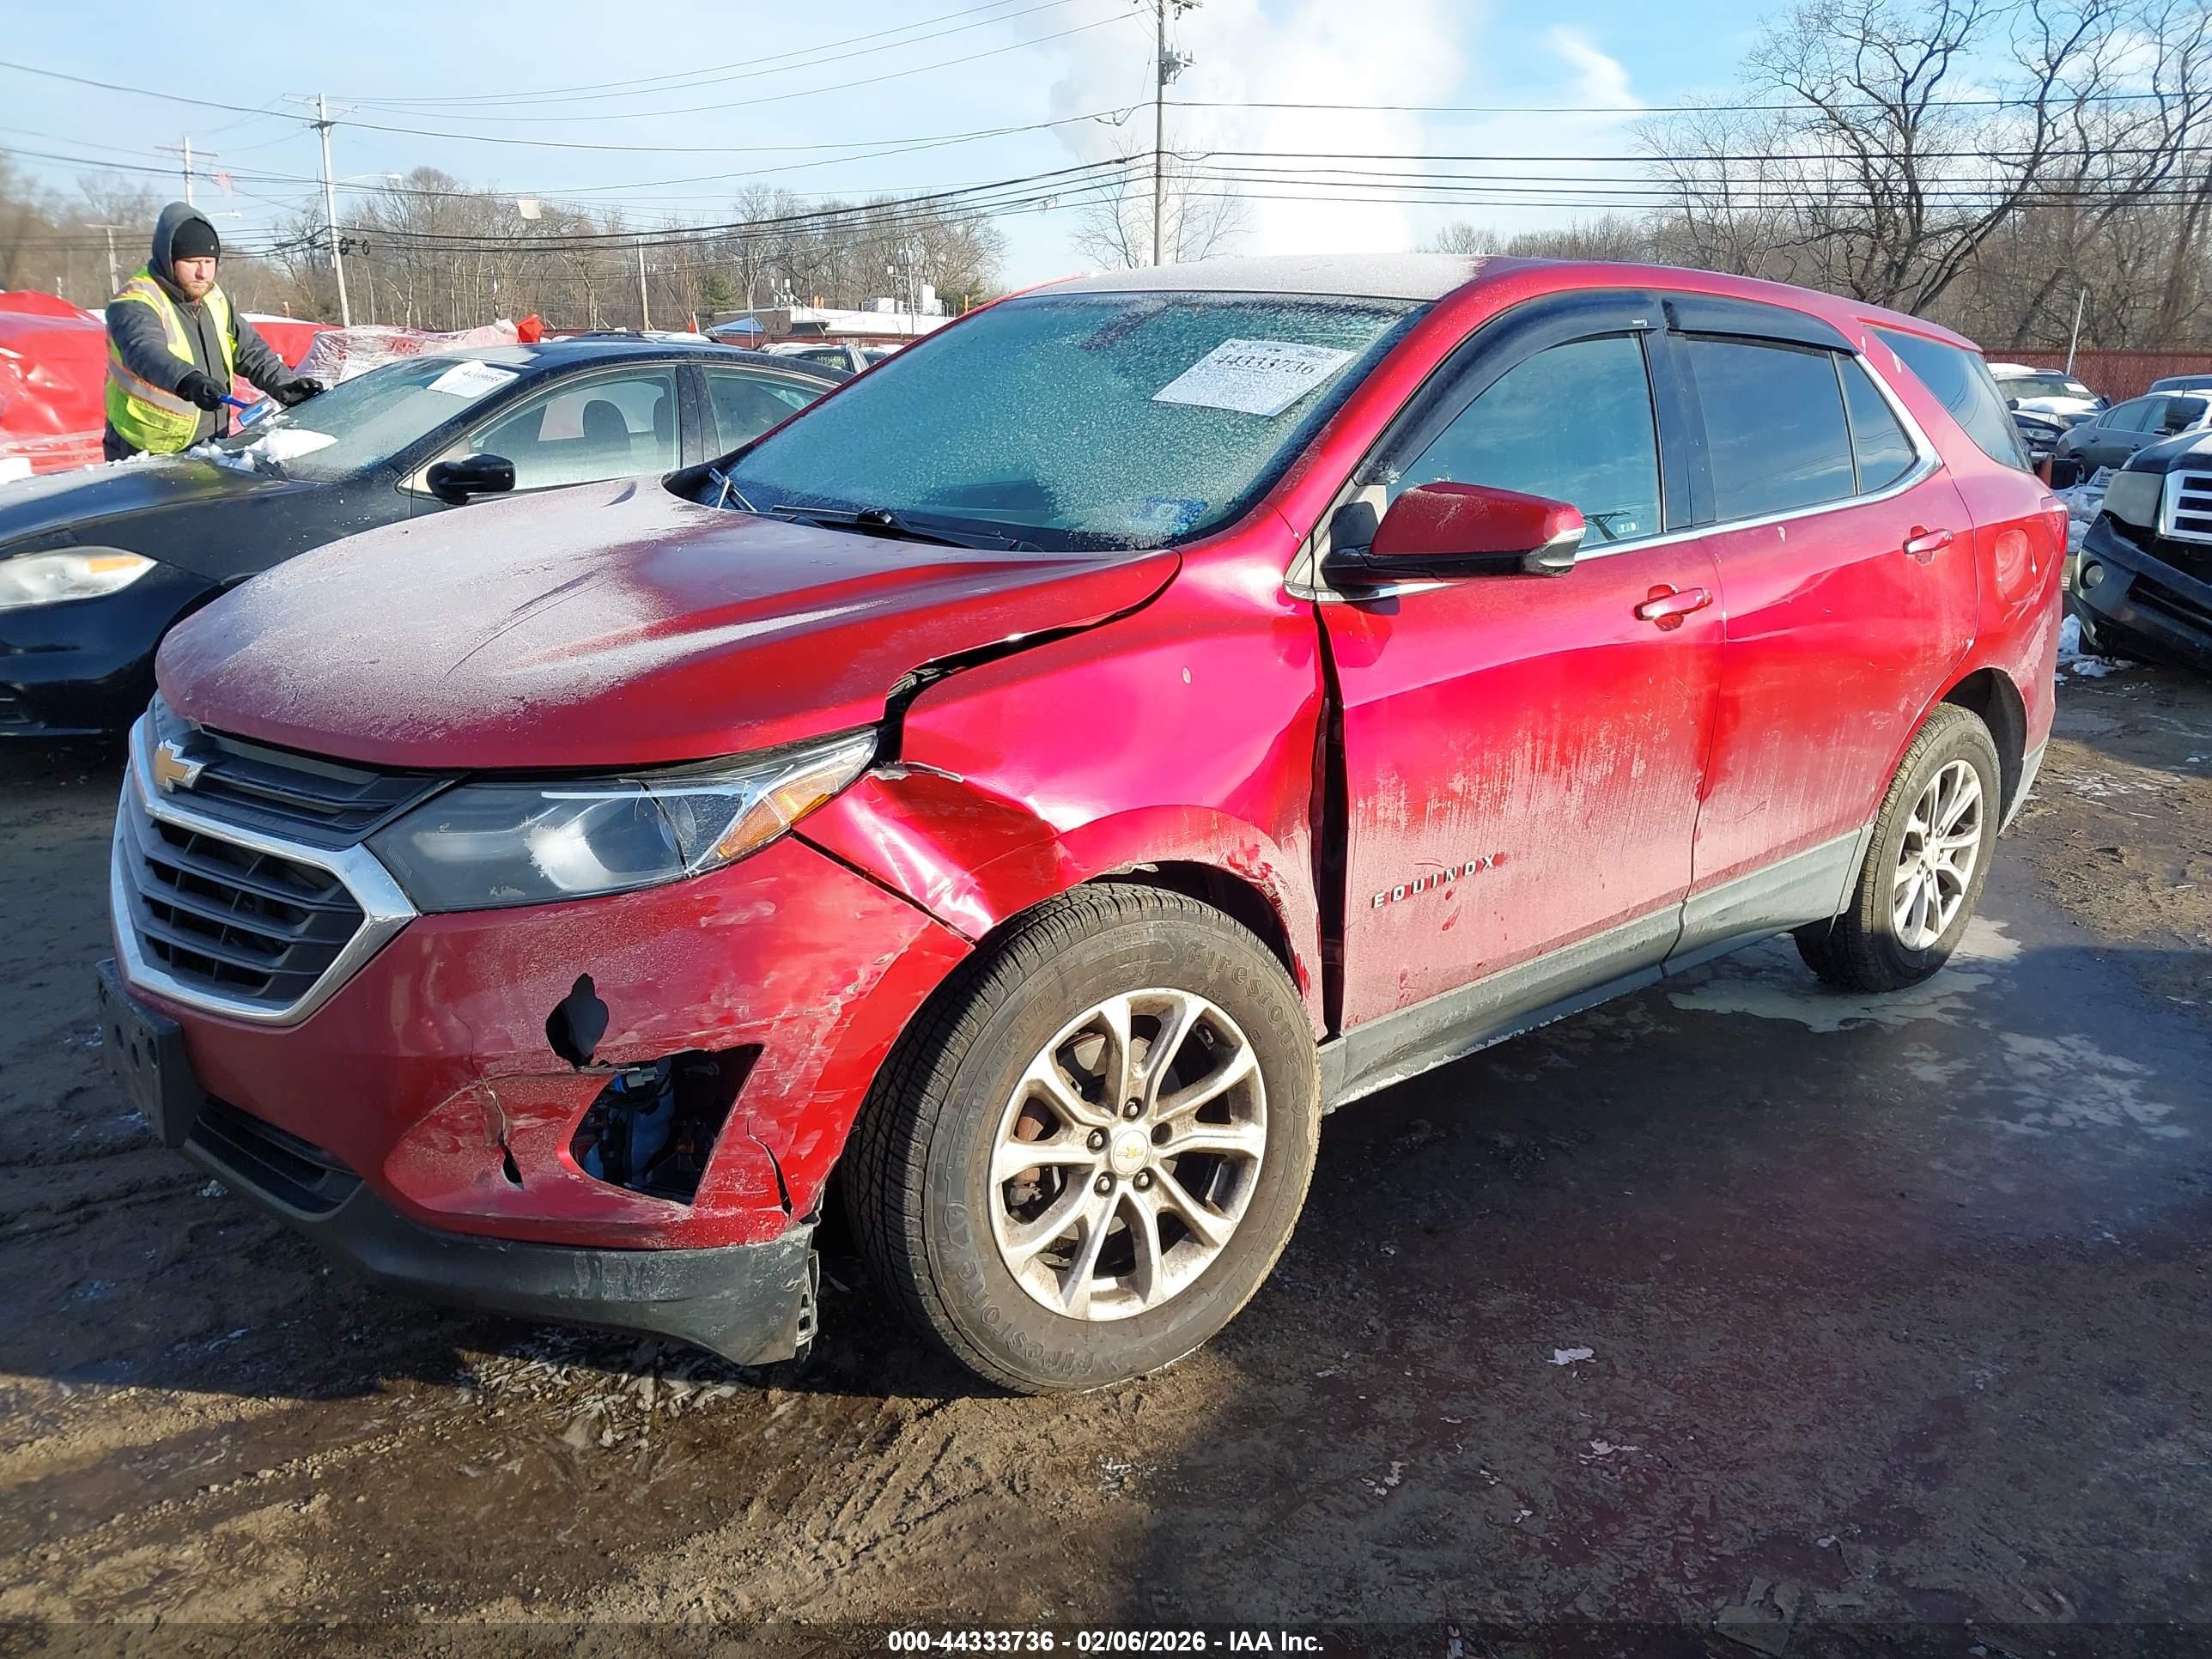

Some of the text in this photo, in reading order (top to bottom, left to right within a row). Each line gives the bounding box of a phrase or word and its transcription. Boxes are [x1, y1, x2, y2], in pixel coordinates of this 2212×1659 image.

[1371, 851, 1498, 909] EQUINOX
[1187, 939, 1302, 1066] Firestone
[957, 1260, 1097, 1376] Firestone
